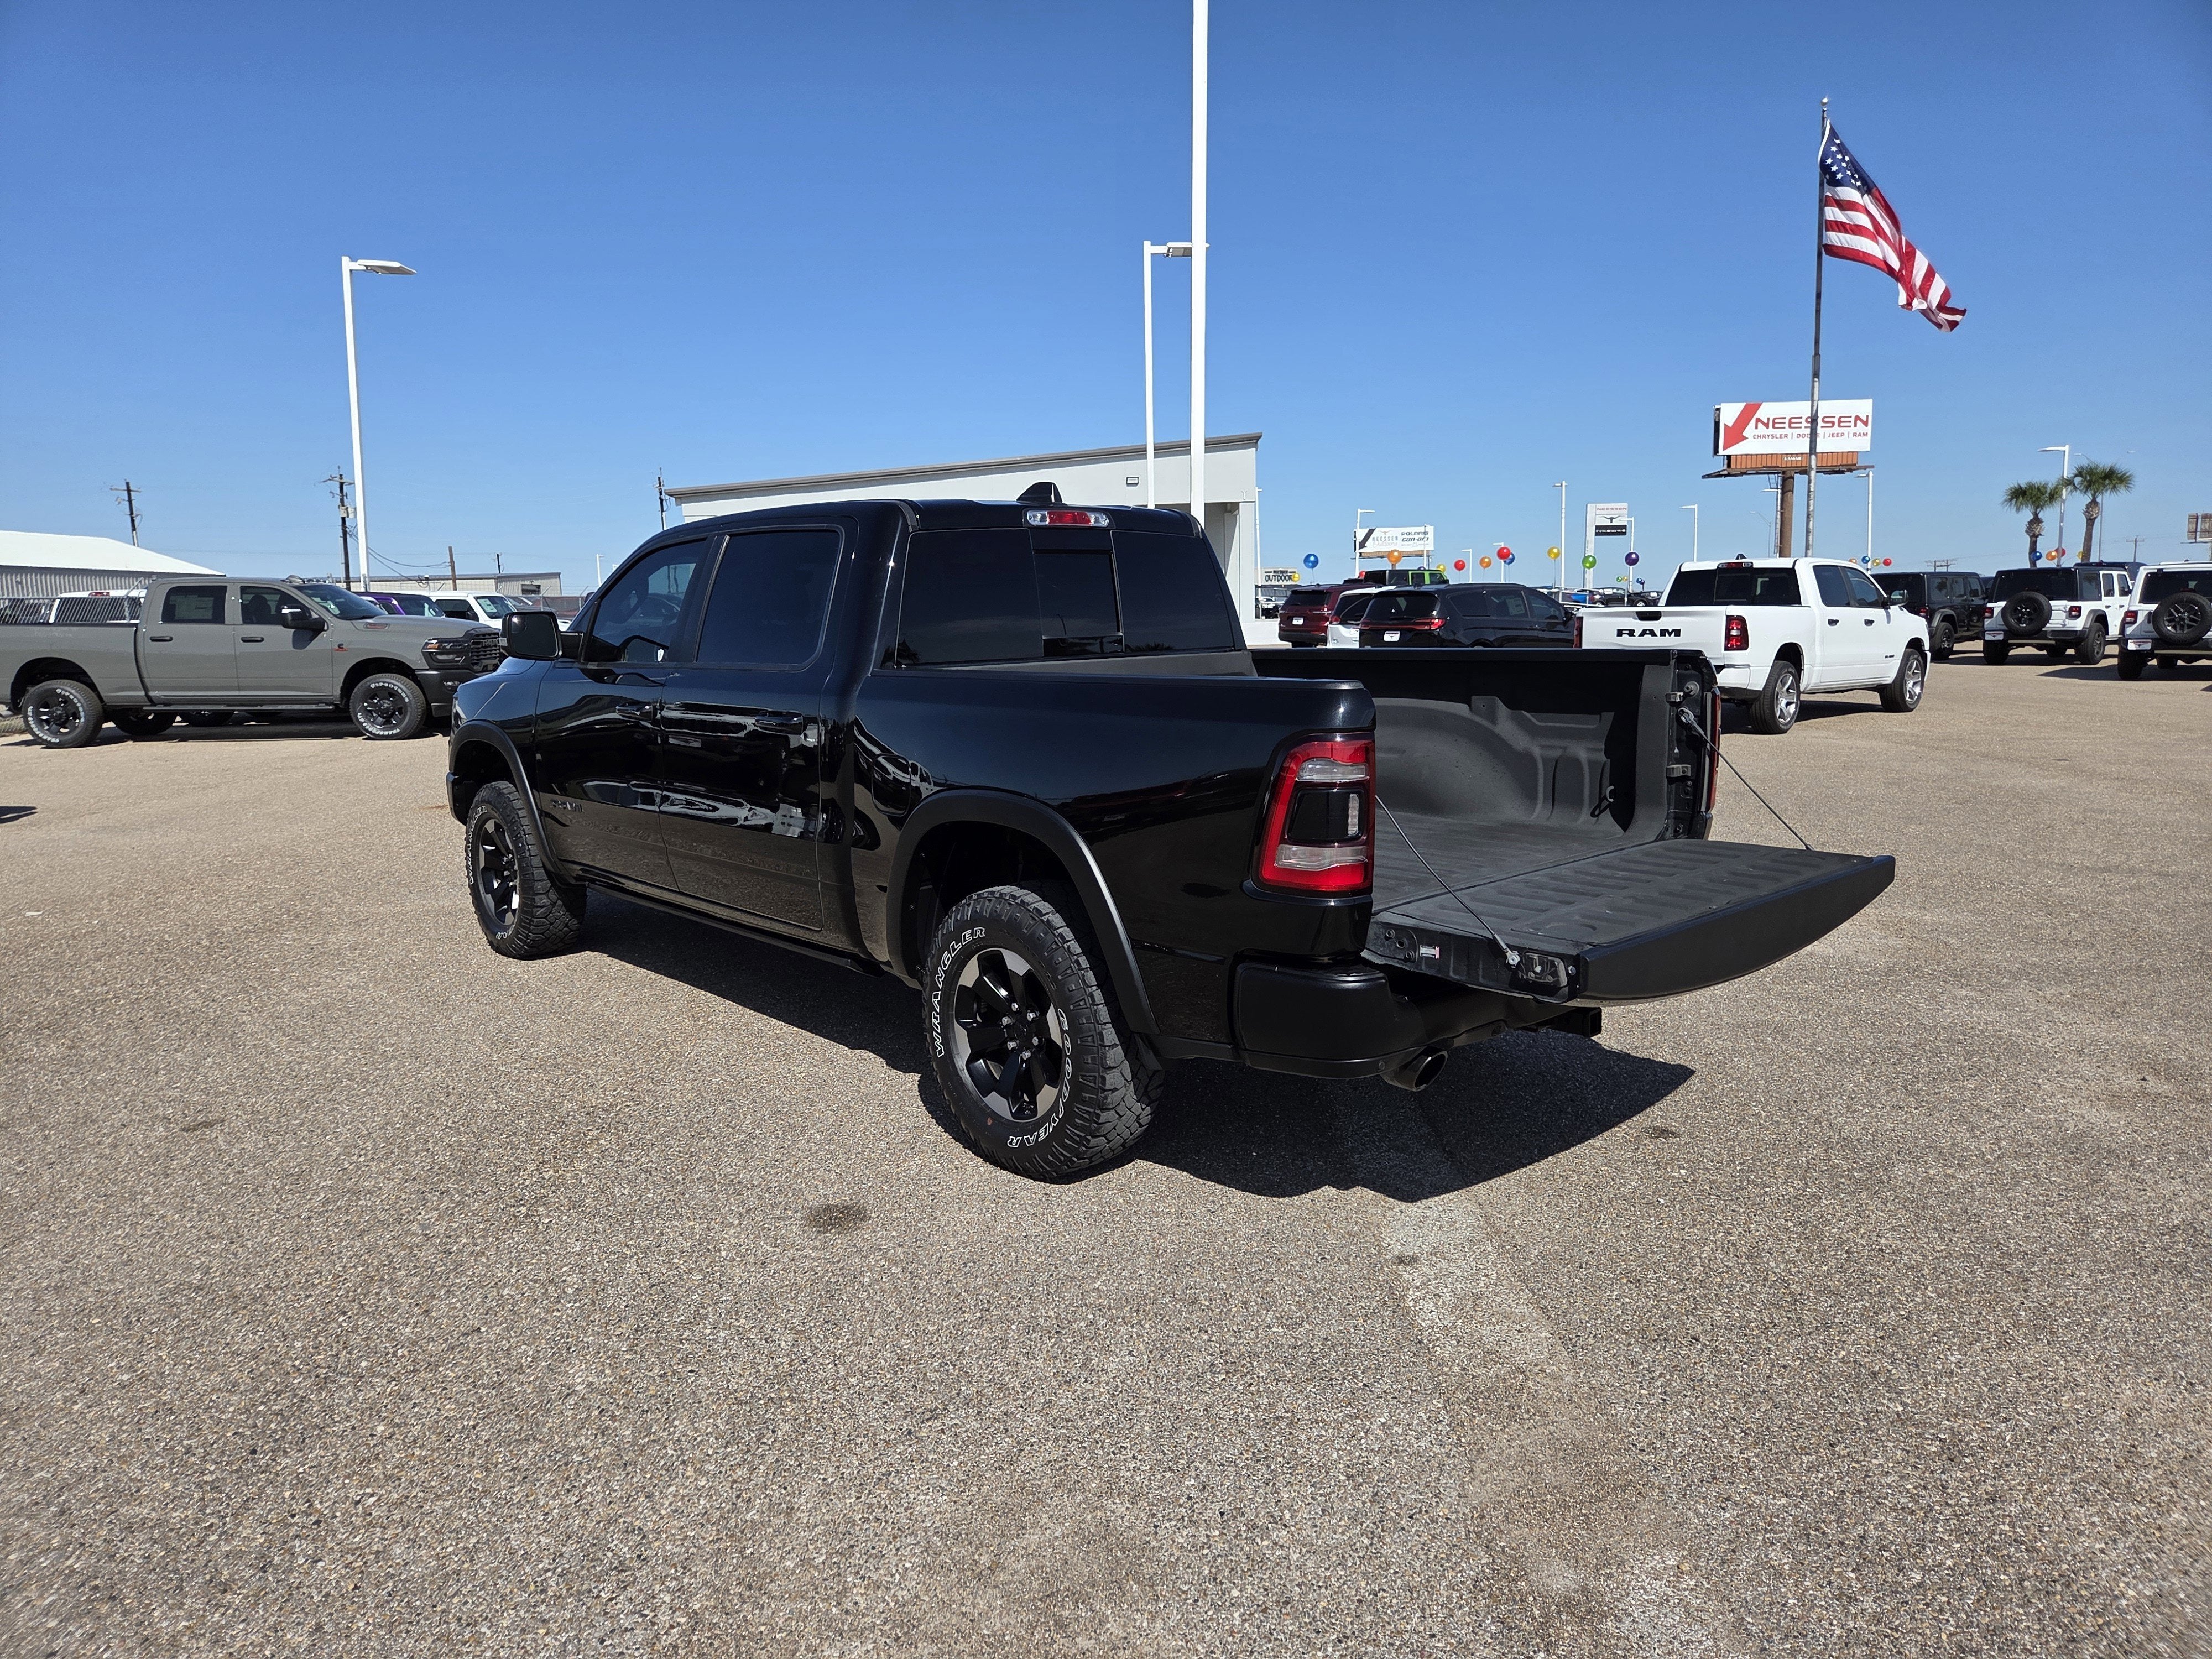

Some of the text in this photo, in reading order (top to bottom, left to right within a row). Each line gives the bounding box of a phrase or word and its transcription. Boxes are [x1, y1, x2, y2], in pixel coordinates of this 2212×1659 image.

[1616, 628, 1681, 637] RAM
[466, 805, 488, 885] WRANGLER
[931, 926, 986, 1058] WRANGLER
[1006, 1008, 1071, 1149] GOODYEAR
